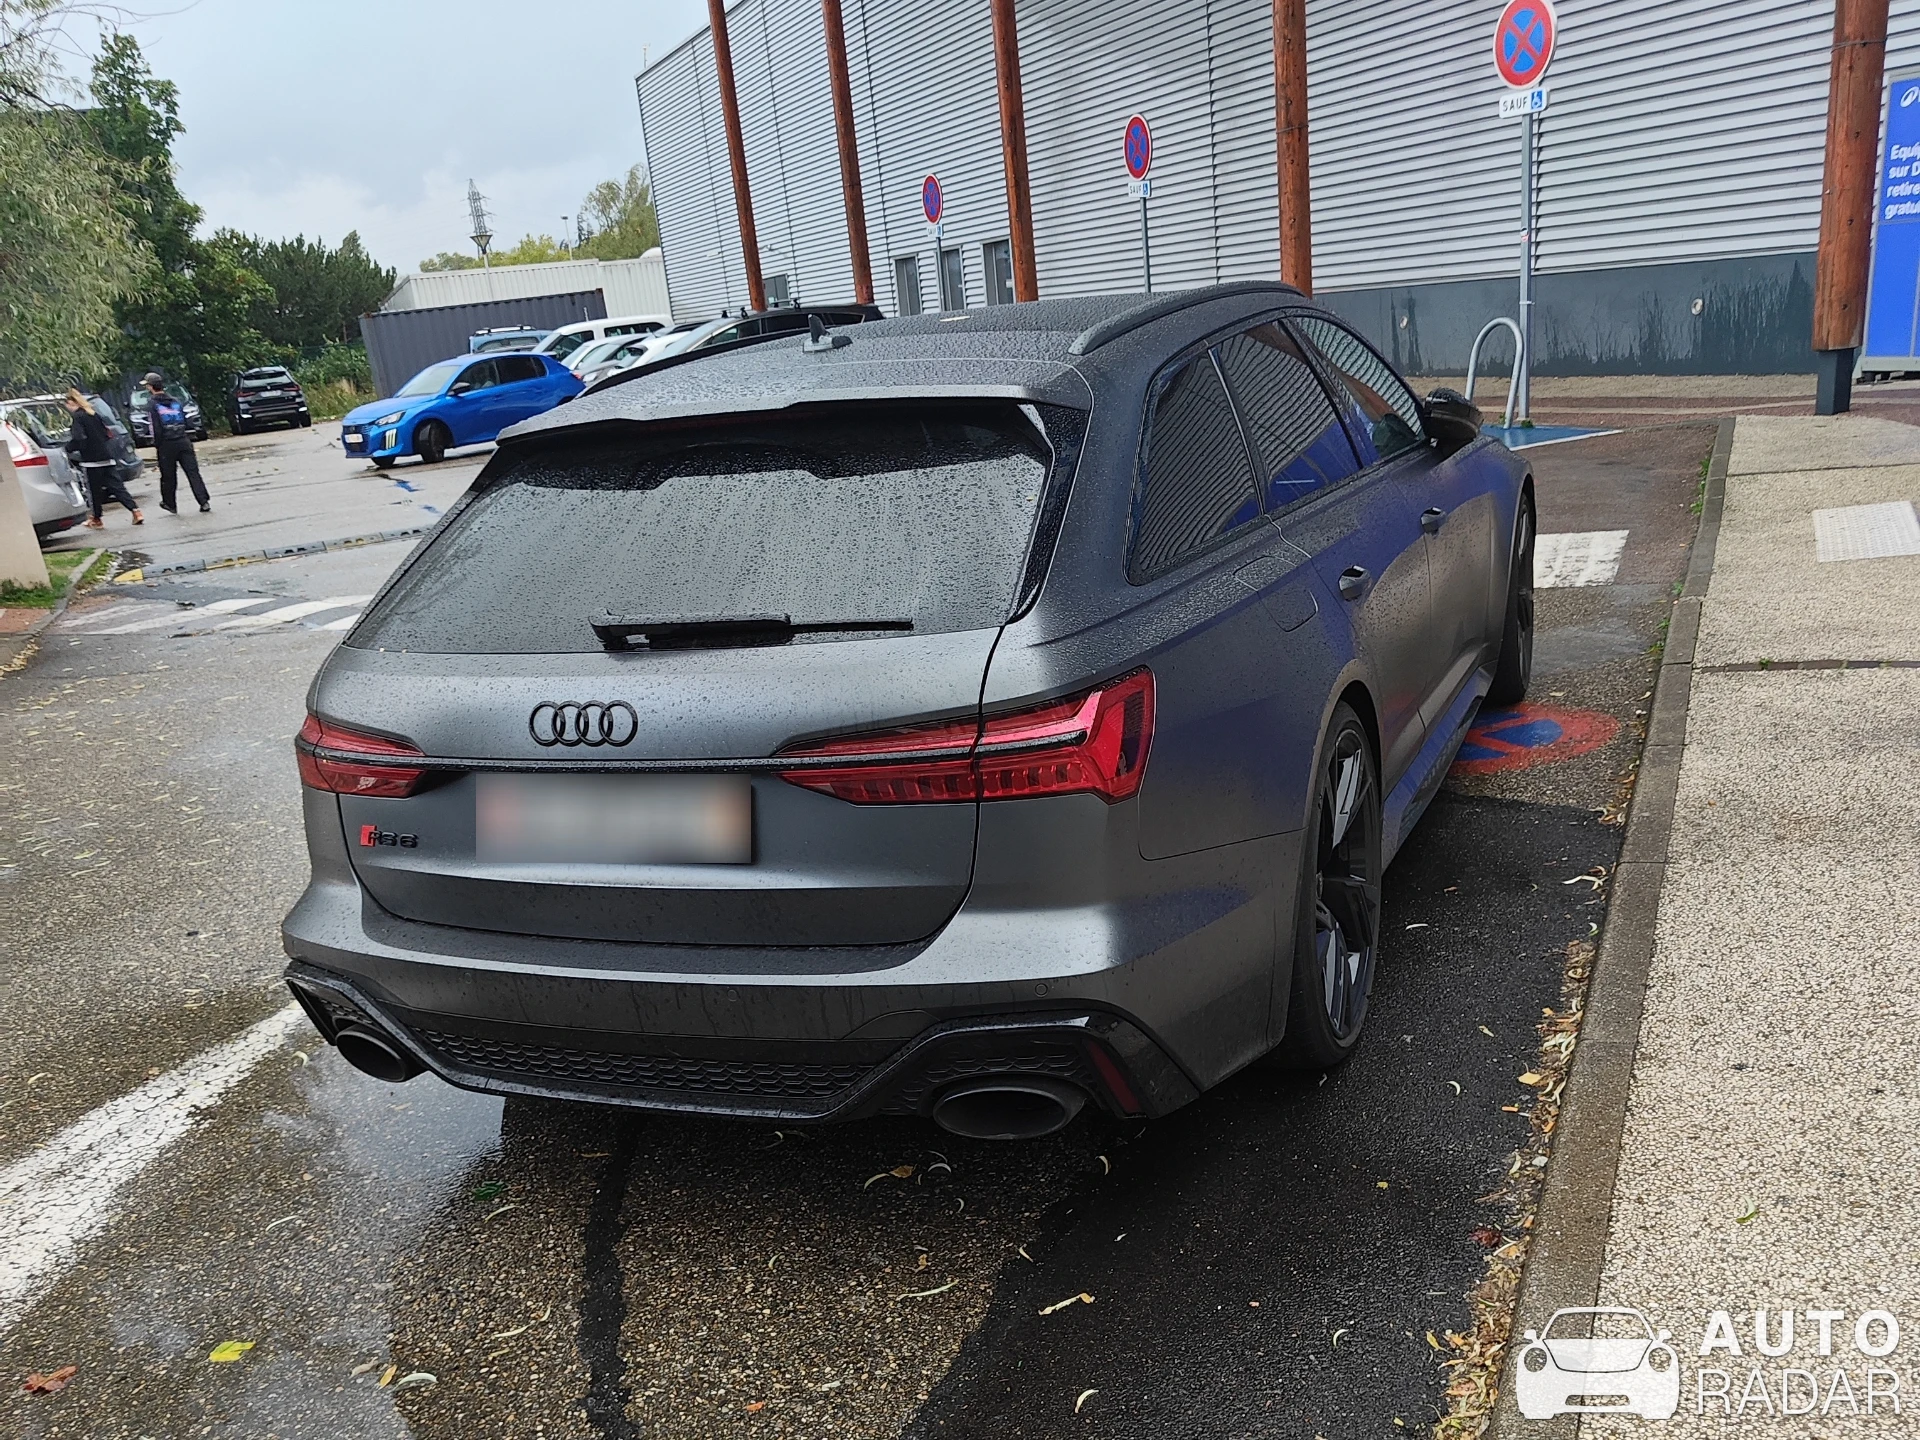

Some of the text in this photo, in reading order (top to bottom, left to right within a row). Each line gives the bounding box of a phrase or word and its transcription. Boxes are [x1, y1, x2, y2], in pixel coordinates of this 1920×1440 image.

[1502, 96, 1528, 112] SAUF
[1888, 165, 1911, 179] sur
[1129, 184, 1142, 194] SAUF
[360, 825, 418, 848] RS6
